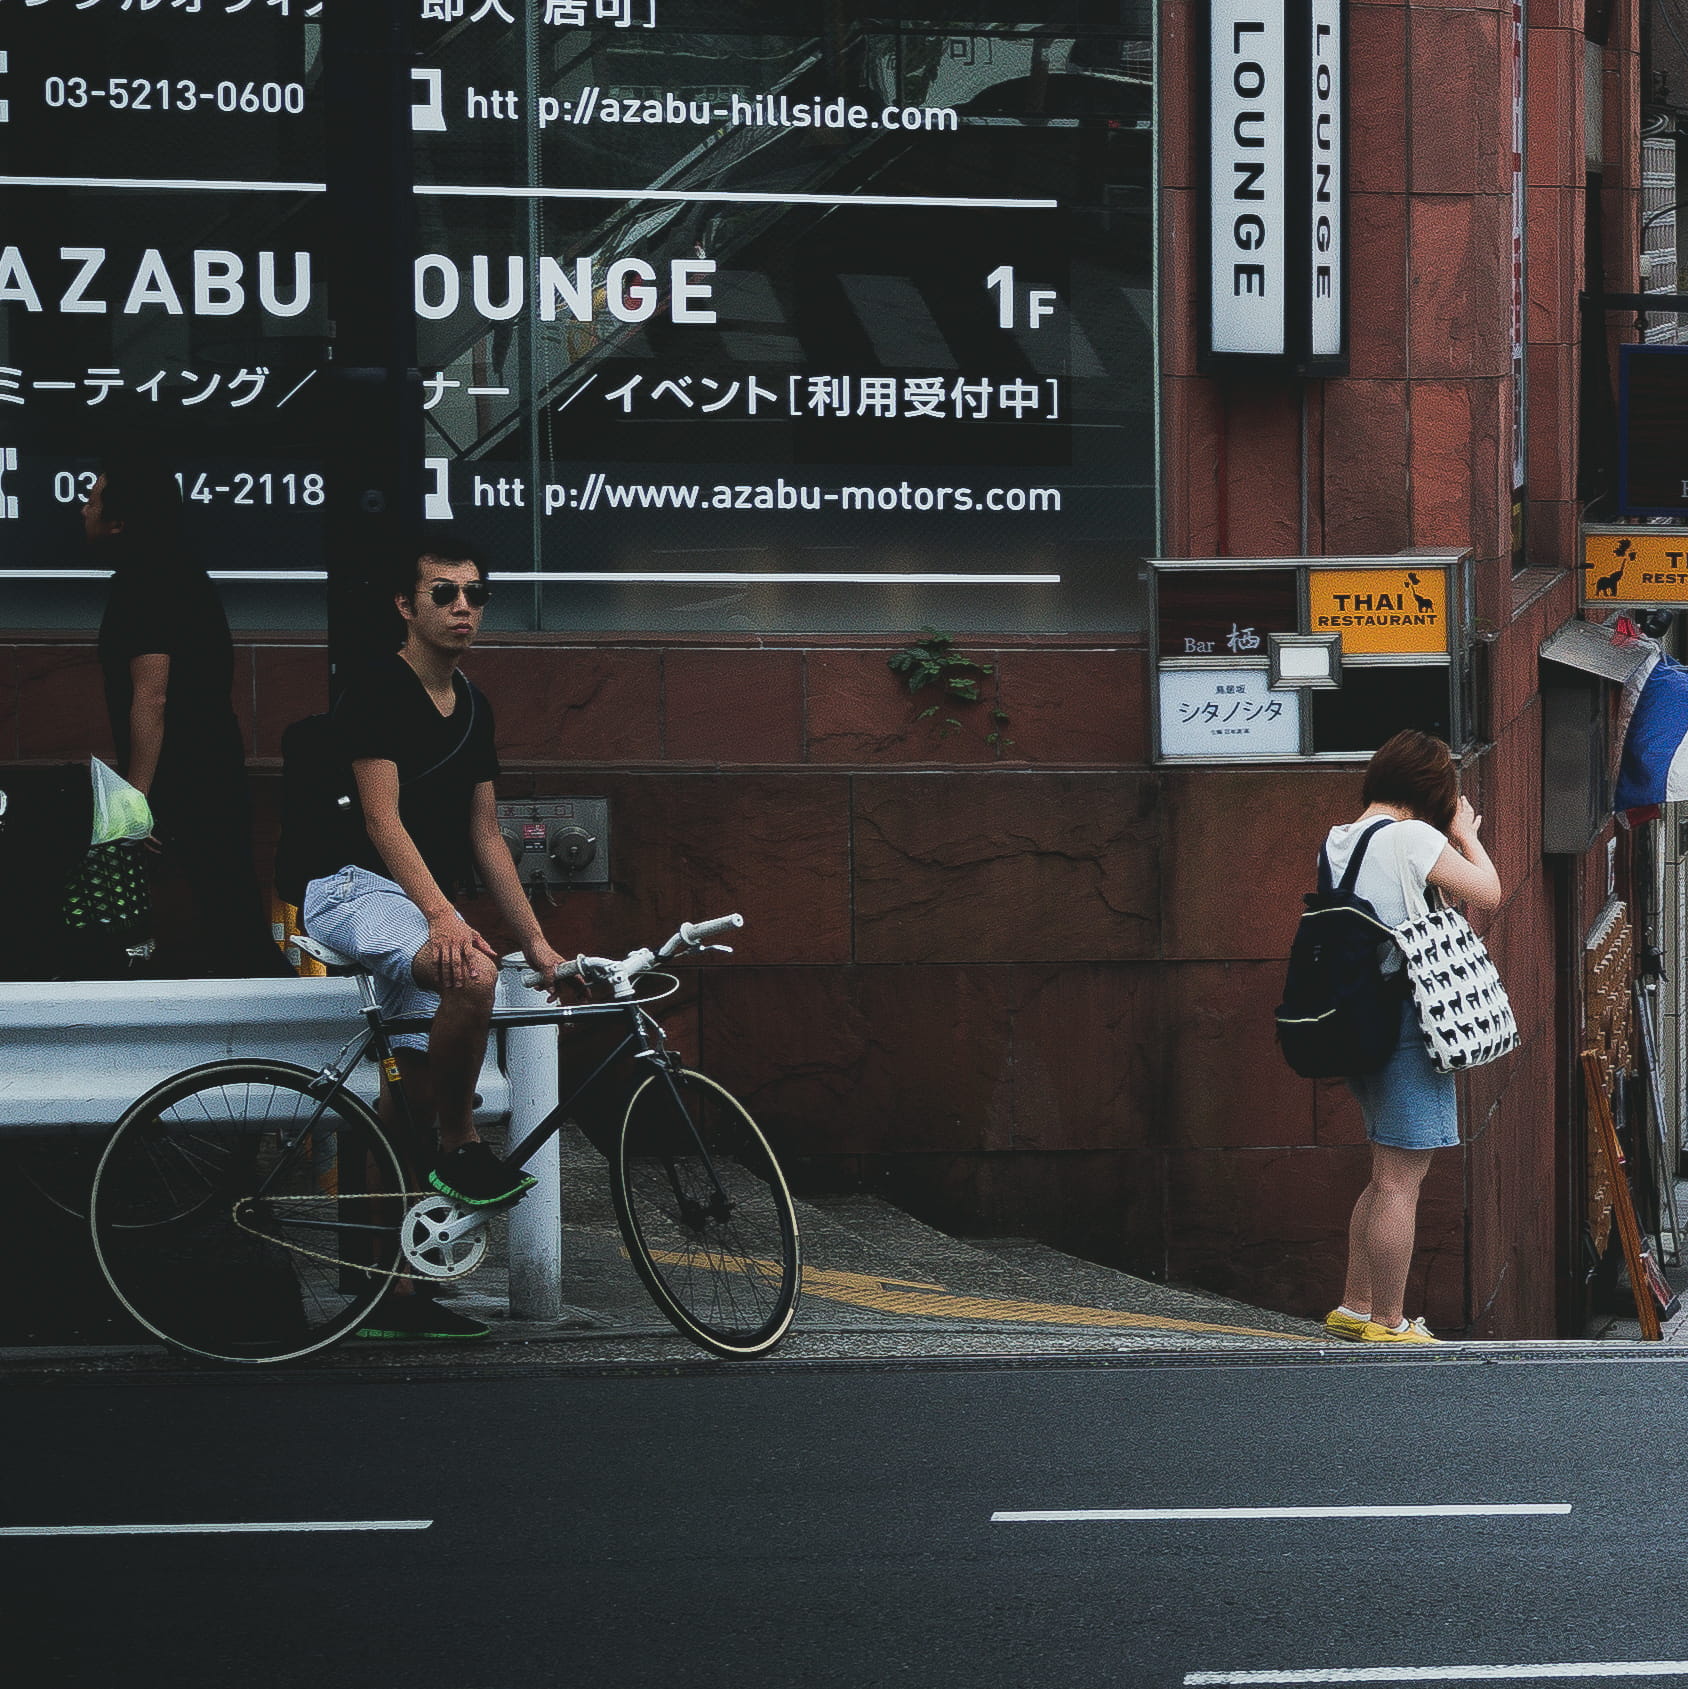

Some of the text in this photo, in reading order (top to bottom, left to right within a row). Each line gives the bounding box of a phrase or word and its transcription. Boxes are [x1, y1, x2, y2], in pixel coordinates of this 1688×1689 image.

[45, 76, 304, 114] 03-5213-0600
[1230, 20, 1267, 300] LOUNGE
[1315, 23, 1332, 301] LOUNGE
[0, 245, 312, 318] AZABU
[413, 253, 717, 325] OUNGE
[1332, 593, 1404, 612] THAI
[1318, 614, 1438, 628] RESTAURANT
[1183, 637, 1216, 653] Bar
[1179, 699, 1283, 723] シタノシタ
